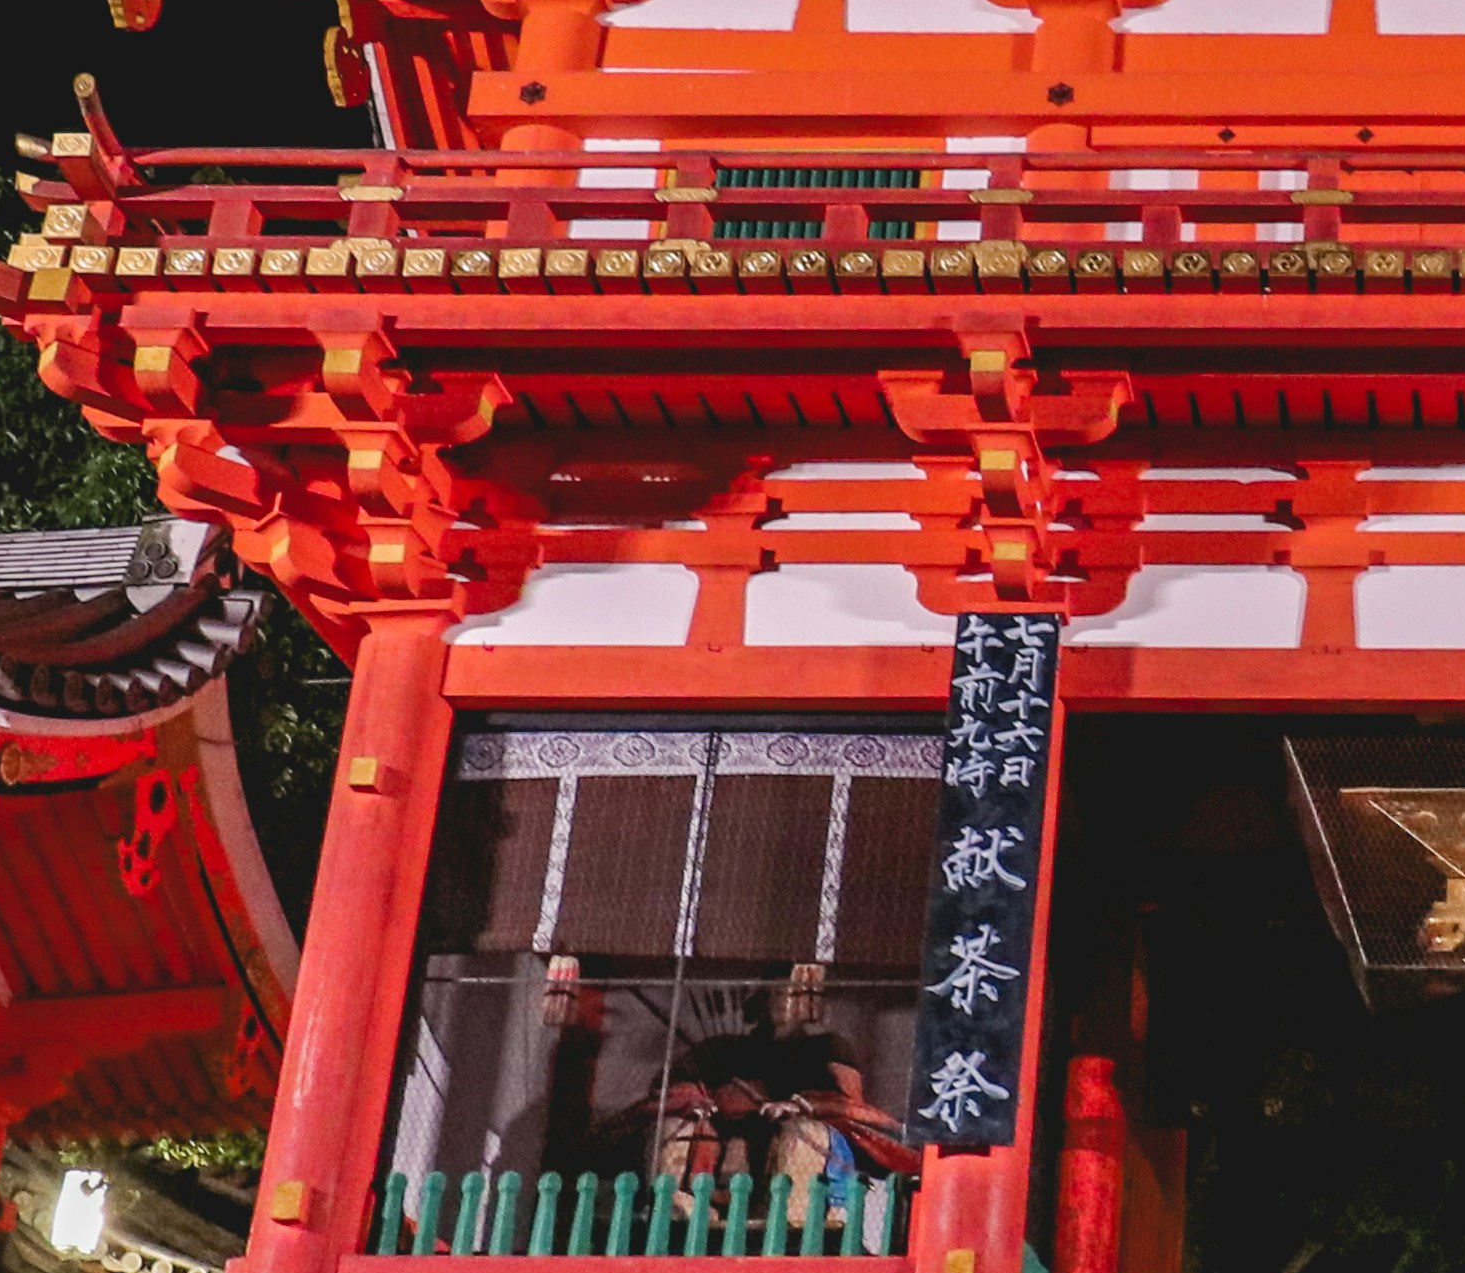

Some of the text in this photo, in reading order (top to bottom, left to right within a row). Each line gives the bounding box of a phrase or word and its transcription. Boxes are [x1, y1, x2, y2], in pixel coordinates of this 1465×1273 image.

[944, 614, 1006, 800] 午前九時
[994, 615, 1055, 788] 七月十六日
[917, 825, 1028, 1134] 献茶祭
